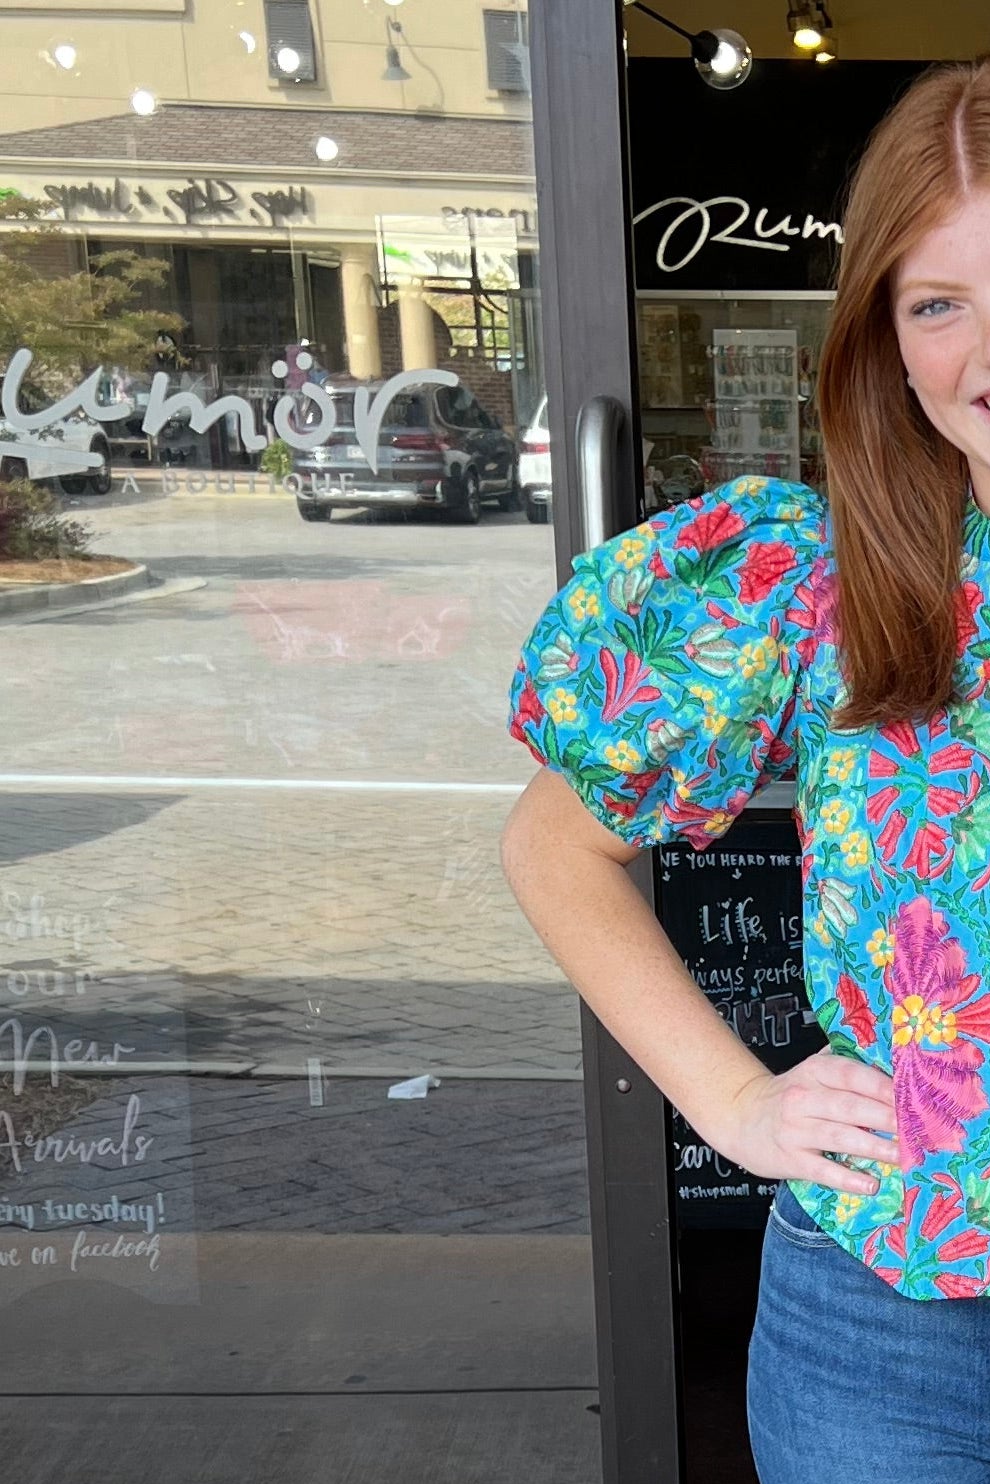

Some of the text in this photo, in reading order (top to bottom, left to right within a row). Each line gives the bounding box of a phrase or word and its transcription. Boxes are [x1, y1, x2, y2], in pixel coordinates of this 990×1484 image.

[162, 471, 356, 500] BOUTIQUE
[685, 852, 716, 870] YOU
[720, 853, 766, 867] HEARD
[769, 854, 791, 867] THE
[700, 897, 799, 945] Life is
[678, 1183, 750, 1200] #shopsmall
[42, 1192, 166, 1234] tuesday!
[31, 1246, 58, 1265] on
[70, 1230, 162, 1273] facebook
